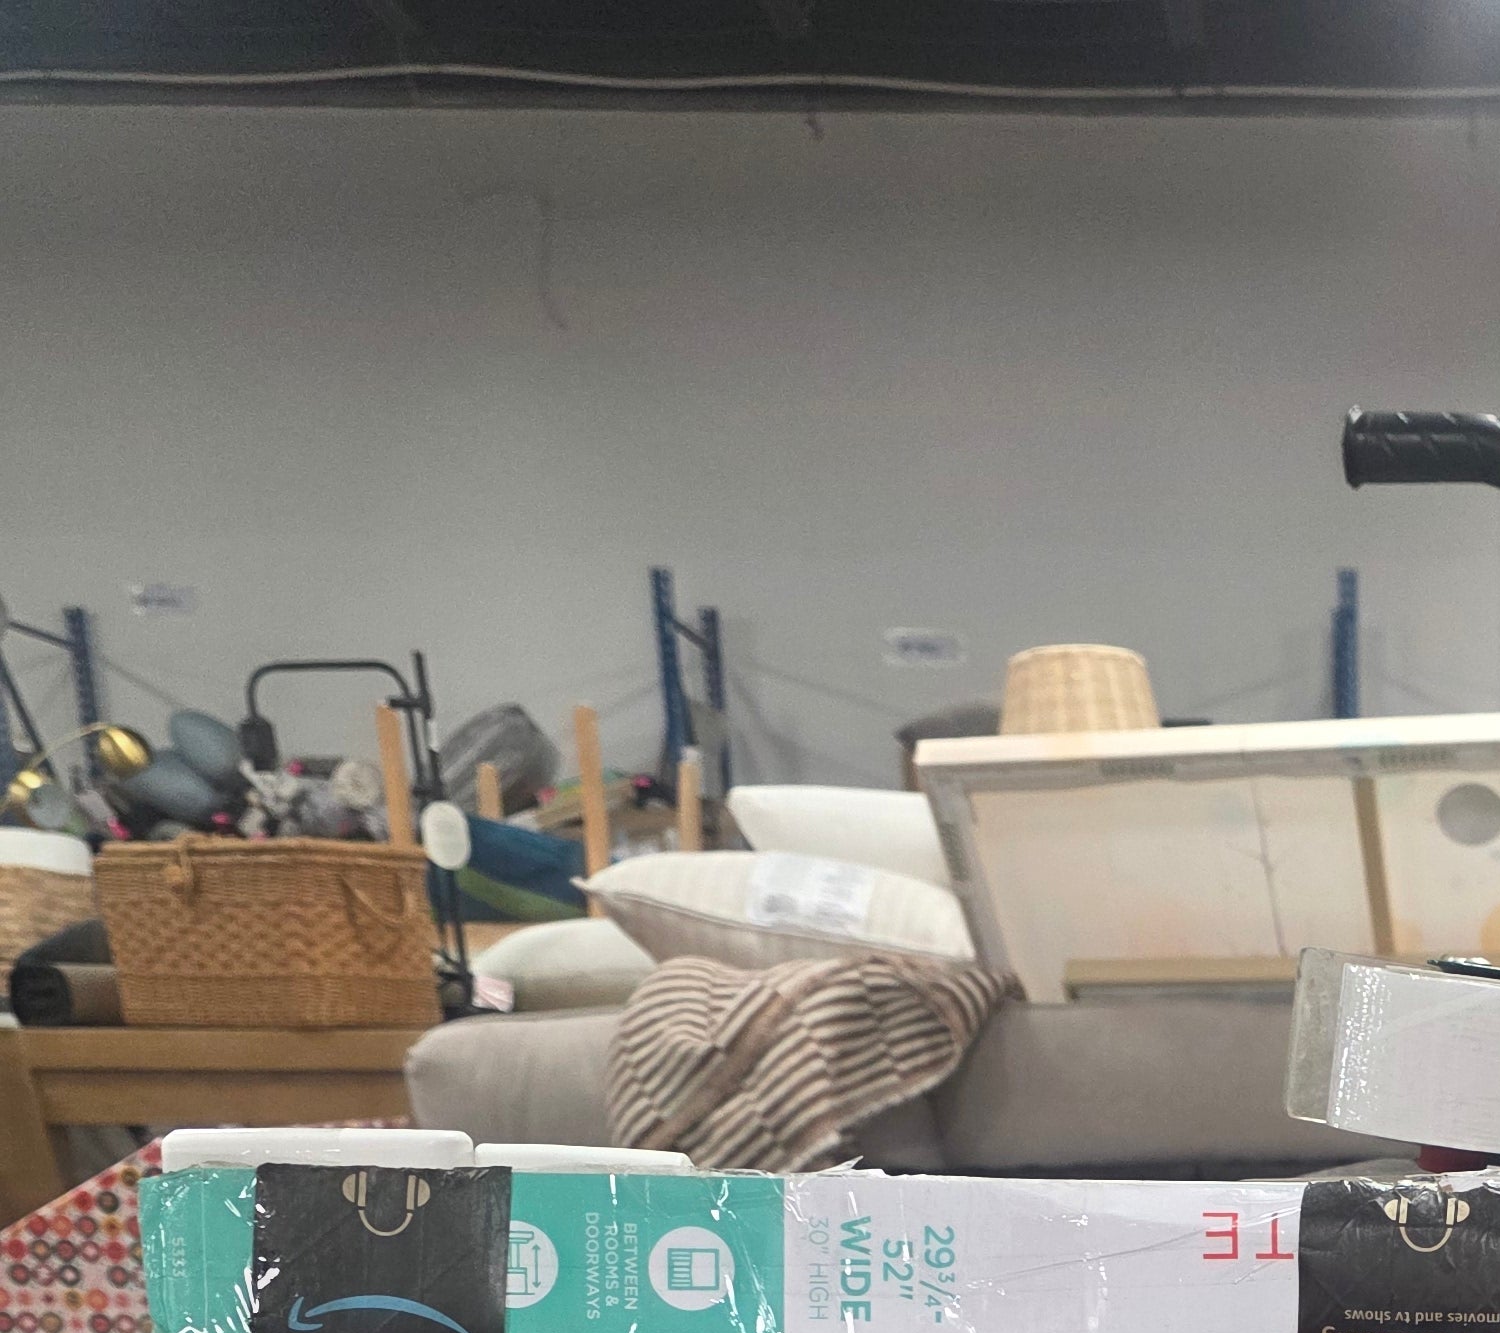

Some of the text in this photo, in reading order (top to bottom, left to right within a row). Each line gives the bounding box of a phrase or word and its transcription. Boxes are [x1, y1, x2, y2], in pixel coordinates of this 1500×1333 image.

[585, 1211, 601, 1320] DOORWAYS
[604, 1225, 620, 1290] ROOMS
[623, 1222, 638, 1311] BETWEEN
[1203, 1211, 1294, 1260] TE
[807, 1263, 829, 1320] HIGH
[840, 1215, 873, 1322] WIDE
[1343, 1308, 1500, 1327] movies and tv shows
